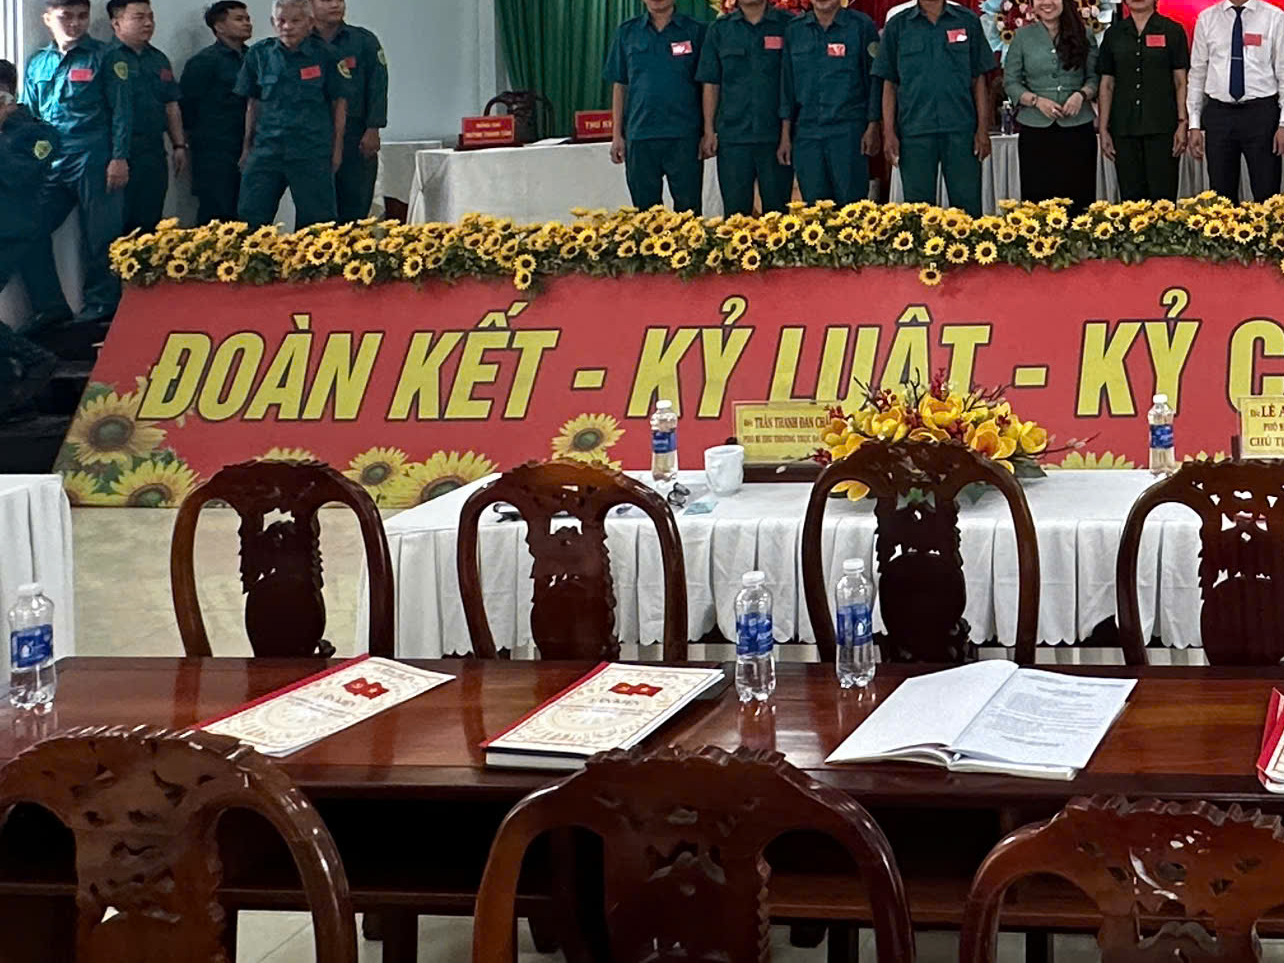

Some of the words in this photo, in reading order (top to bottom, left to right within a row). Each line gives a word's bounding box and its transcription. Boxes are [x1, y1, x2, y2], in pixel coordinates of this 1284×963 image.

[136, 313, 384, 422] ĐOÀN
[387, 301, 561, 421] KẾT
[571, 367, 607, 391] -
[625, 294, 756, 420] KỶ
[1013, 366, 1048, 388] -
[1074, 287, 1202, 418] KỶ
[1250, 436, 1271, 446] CHỦ
